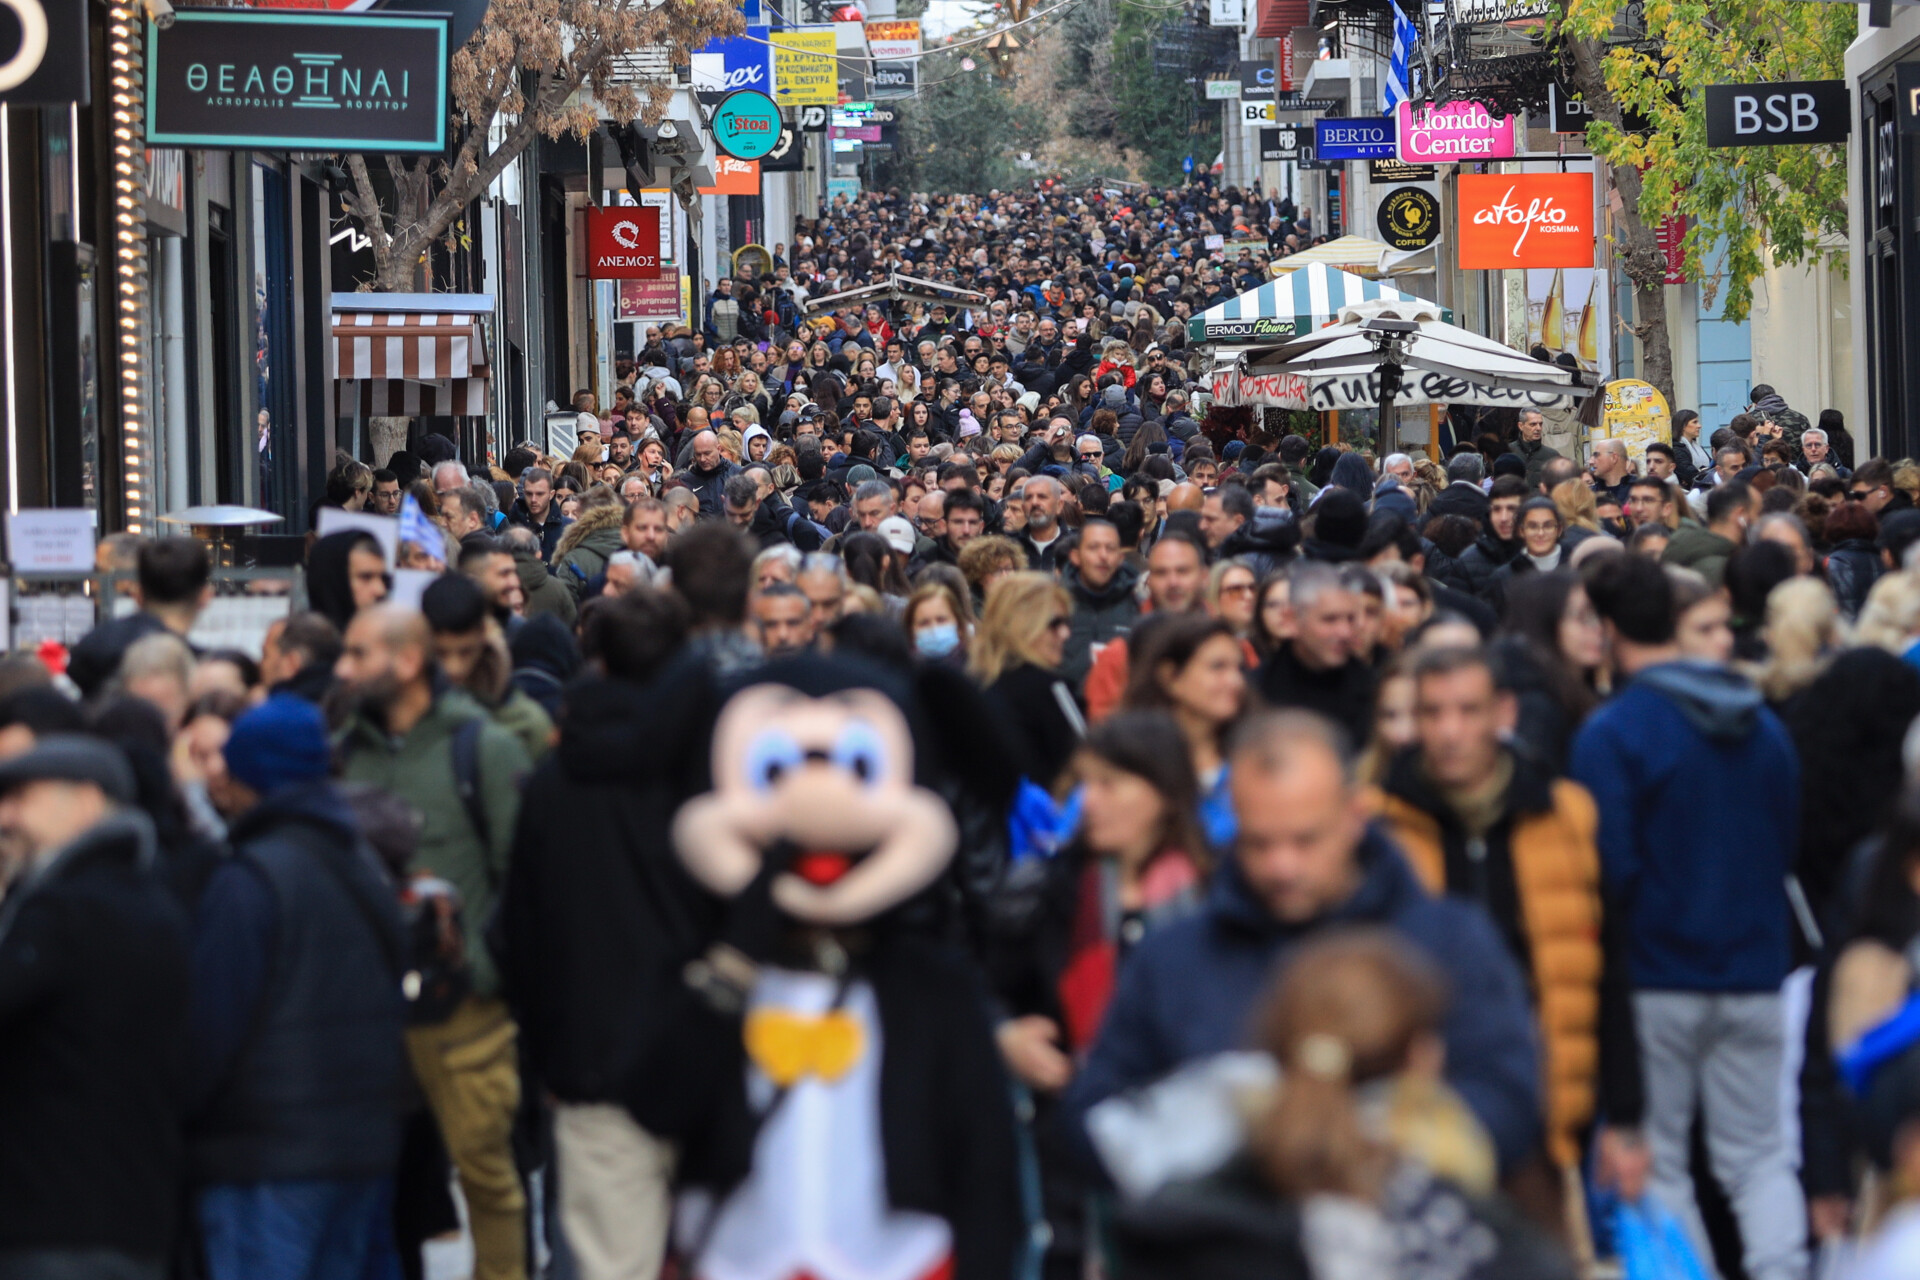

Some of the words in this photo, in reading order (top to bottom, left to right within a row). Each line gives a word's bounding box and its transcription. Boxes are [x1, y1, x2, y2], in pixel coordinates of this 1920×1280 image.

[207, 95, 285, 108] ACROPOLIS
[346, 99, 409, 112] ROOFTOP
[1410, 104, 1505, 131] Hondos
[1734, 93, 1819, 136] BSB
[729, 117, 769, 131] iStoa
[1324, 128, 1385, 144] BERTO
[1410, 130, 1495, 156] Center
[1357, 146, 1396, 154] MILA
[1540, 225, 1580, 233] KOSMIMA
[1395, 238, 1426, 247] COFFEE
[597, 256, 655, 267] ΑΝΕΜΟΣ
[1206, 325, 1252, 336] ERMOU
[1253, 320, 1294, 334] Flower
